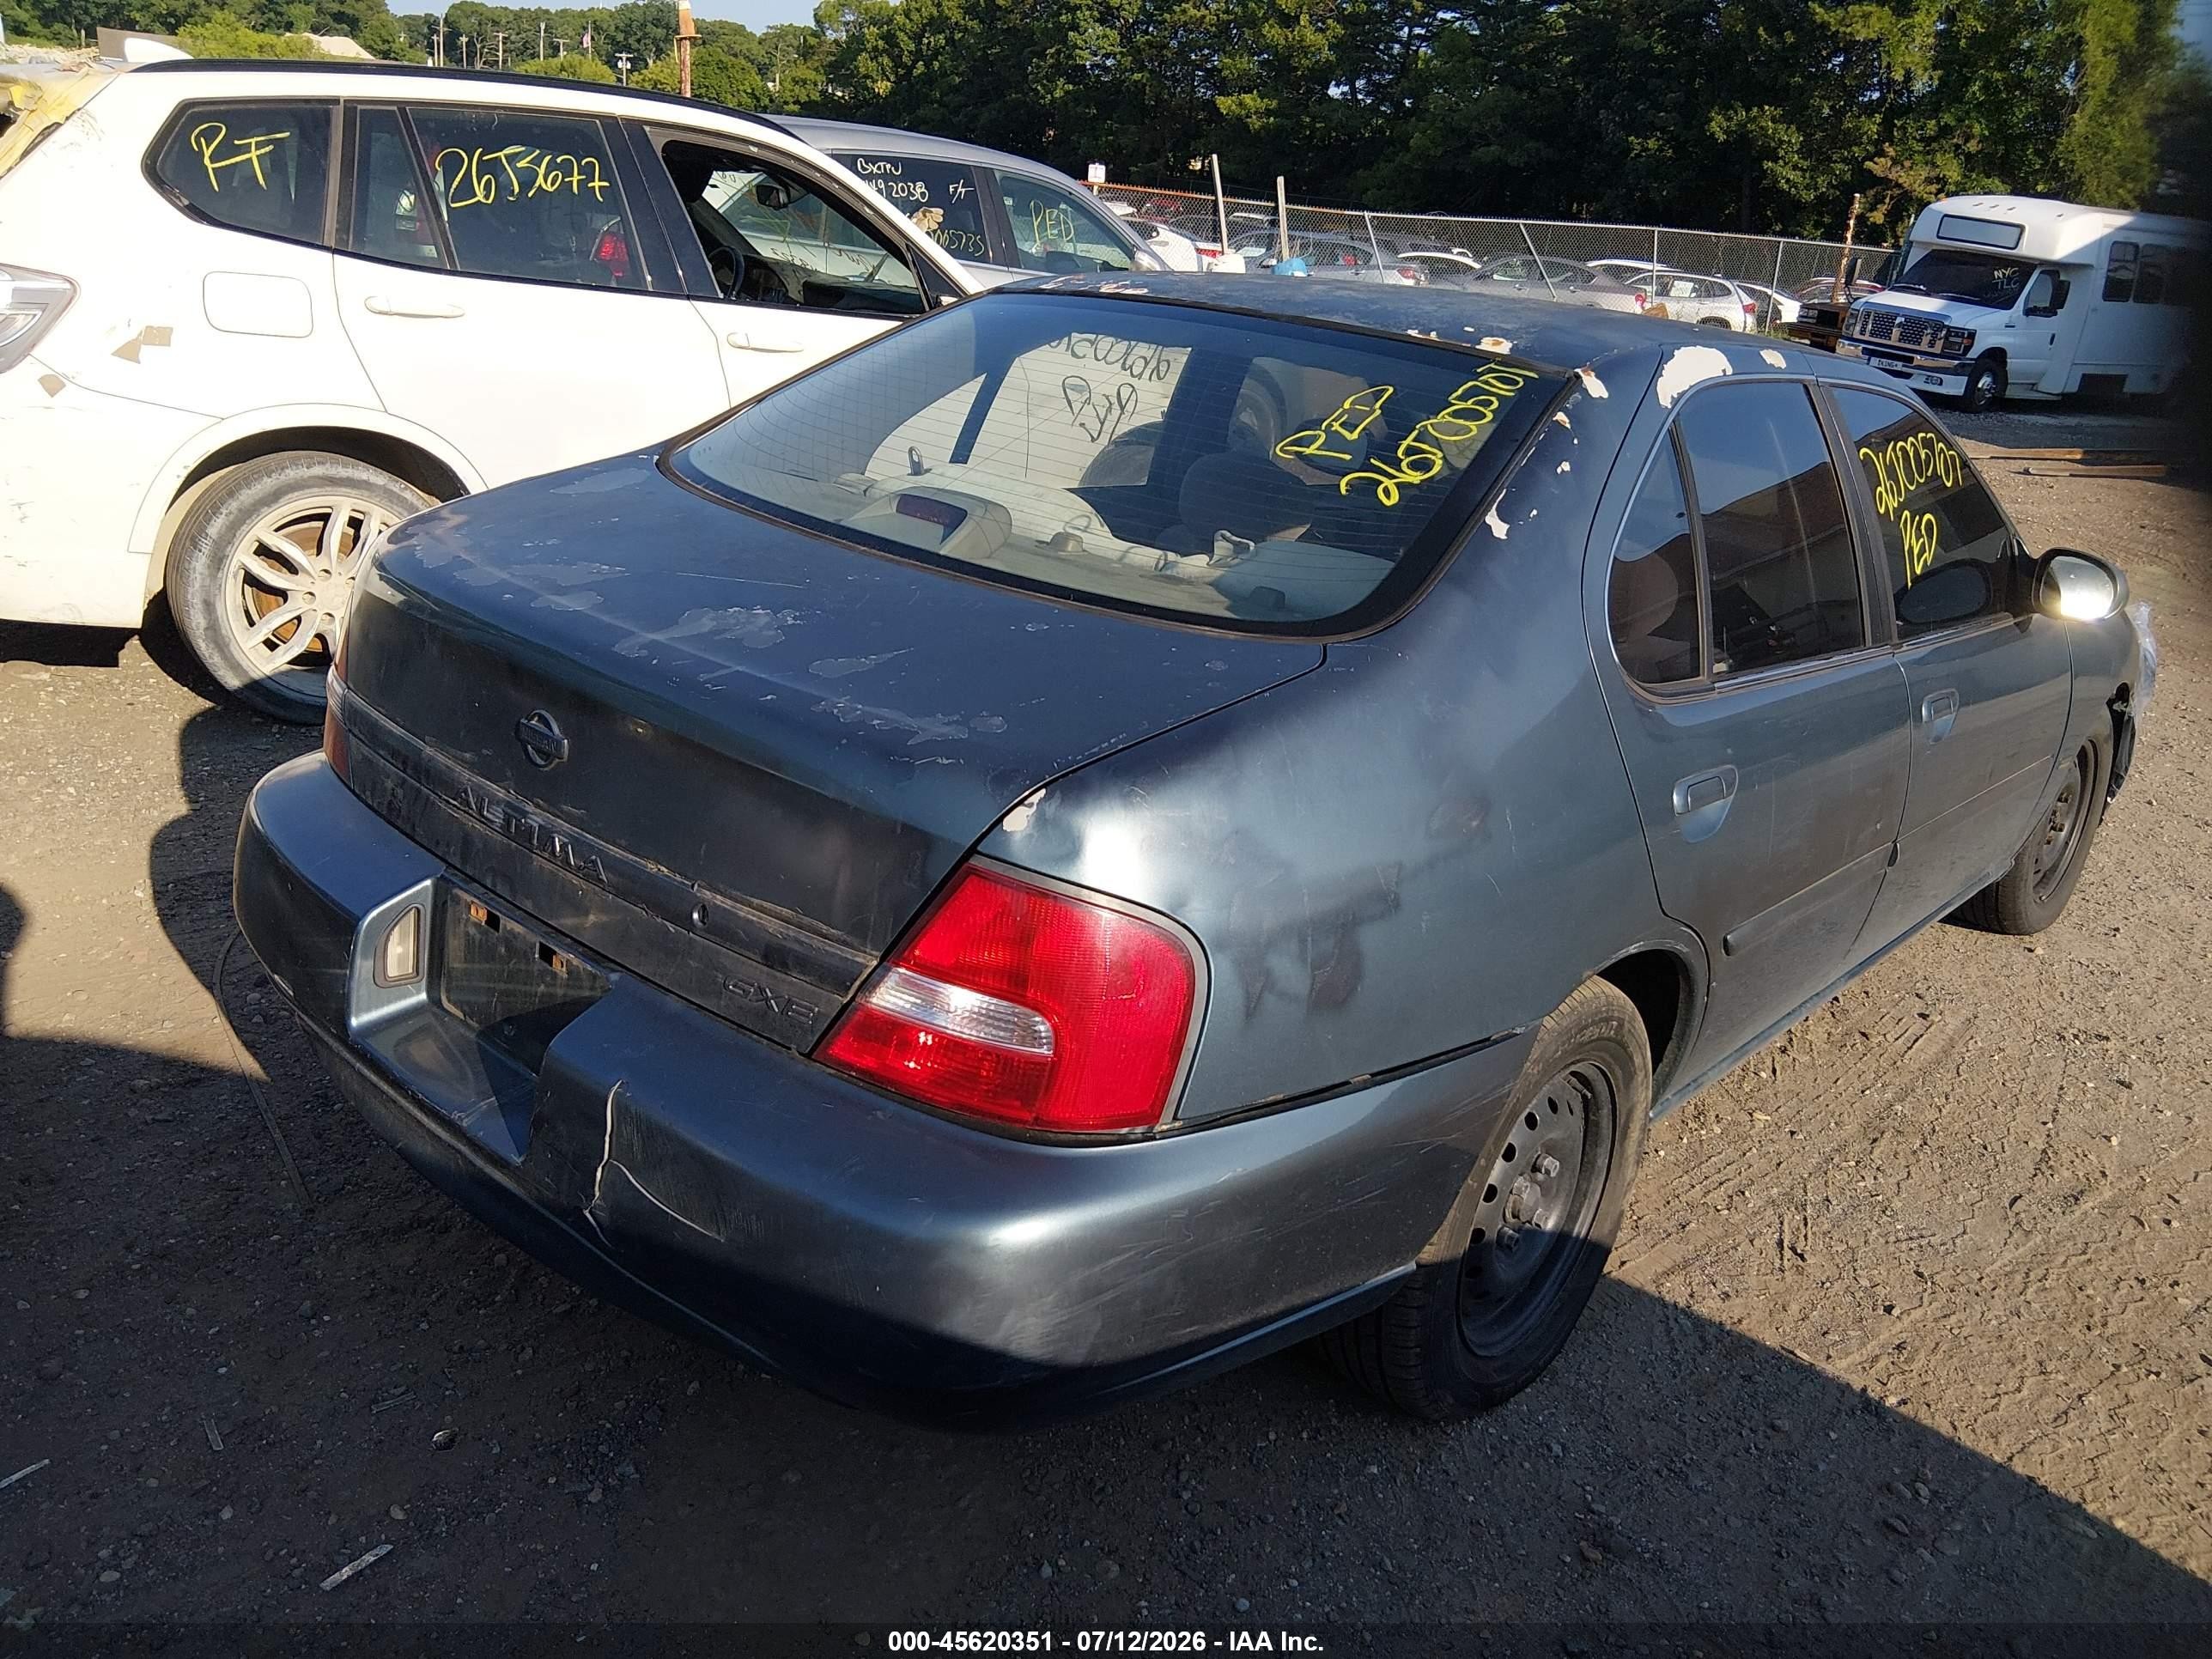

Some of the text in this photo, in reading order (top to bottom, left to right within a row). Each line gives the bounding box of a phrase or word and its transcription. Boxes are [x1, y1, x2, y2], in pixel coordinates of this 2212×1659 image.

[949, 179, 975, 204] F/T
[1030, 199, 1074, 246] PED
[1991, 276, 2020, 289] TLC
[1899, 509, 1938, 590] PED
